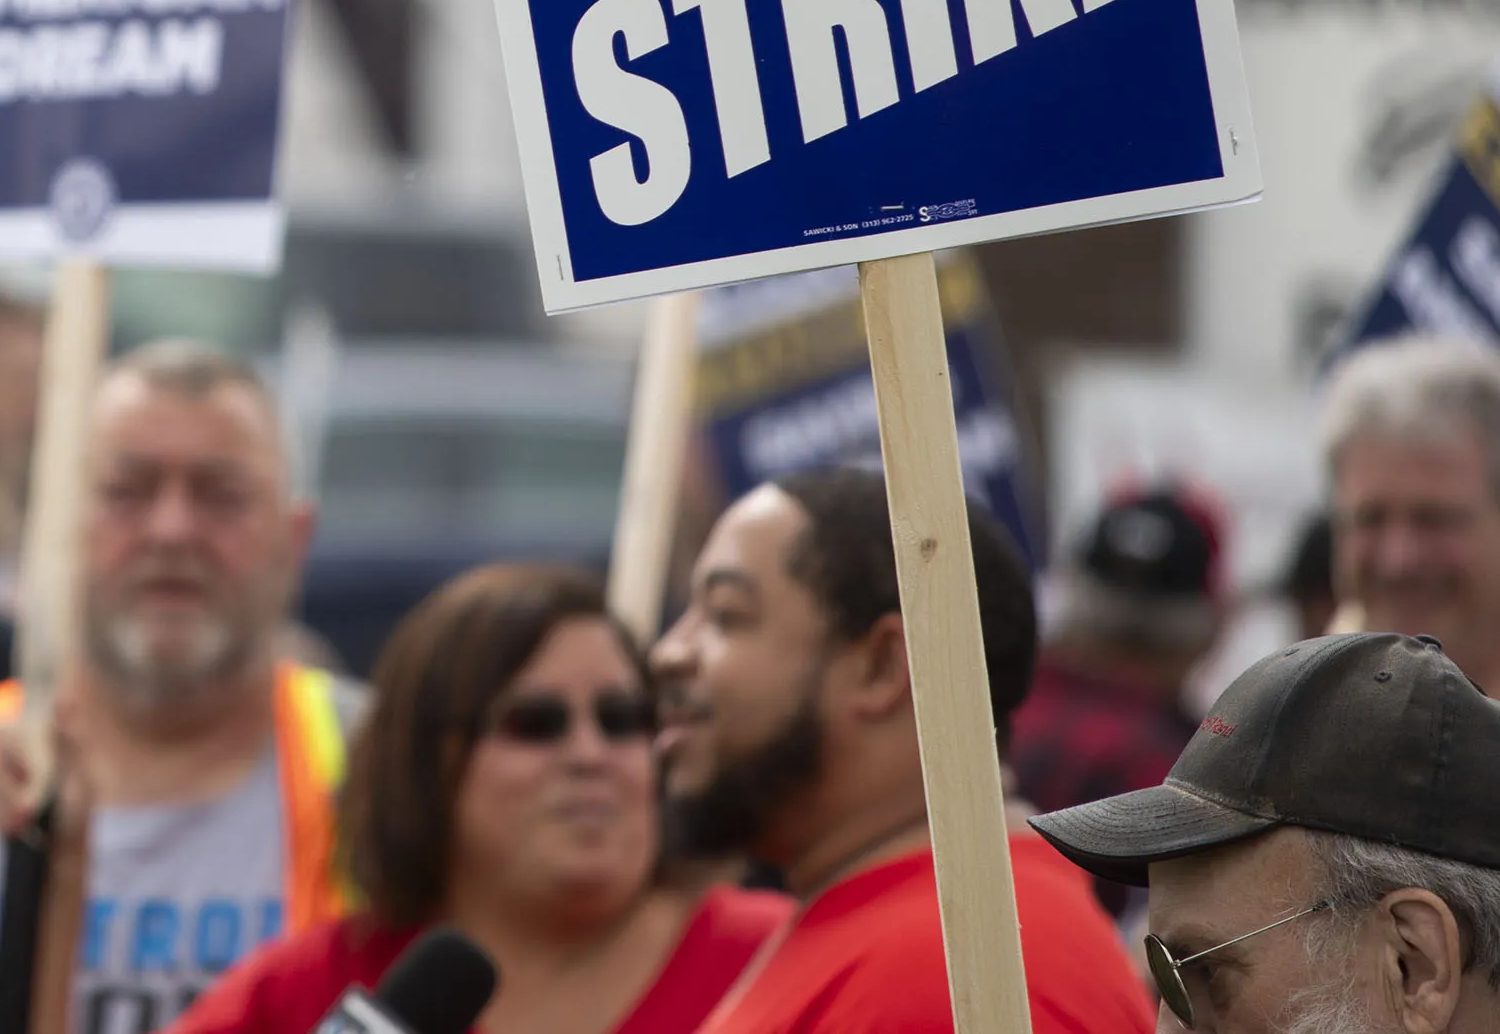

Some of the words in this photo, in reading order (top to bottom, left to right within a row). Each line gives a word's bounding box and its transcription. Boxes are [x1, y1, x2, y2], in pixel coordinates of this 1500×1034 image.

[803, 226, 835, 237] SAWICKI
[835, 225, 842, 233] &
[843, 222, 859, 231] SON
[861, 218, 881, 229] (313)
